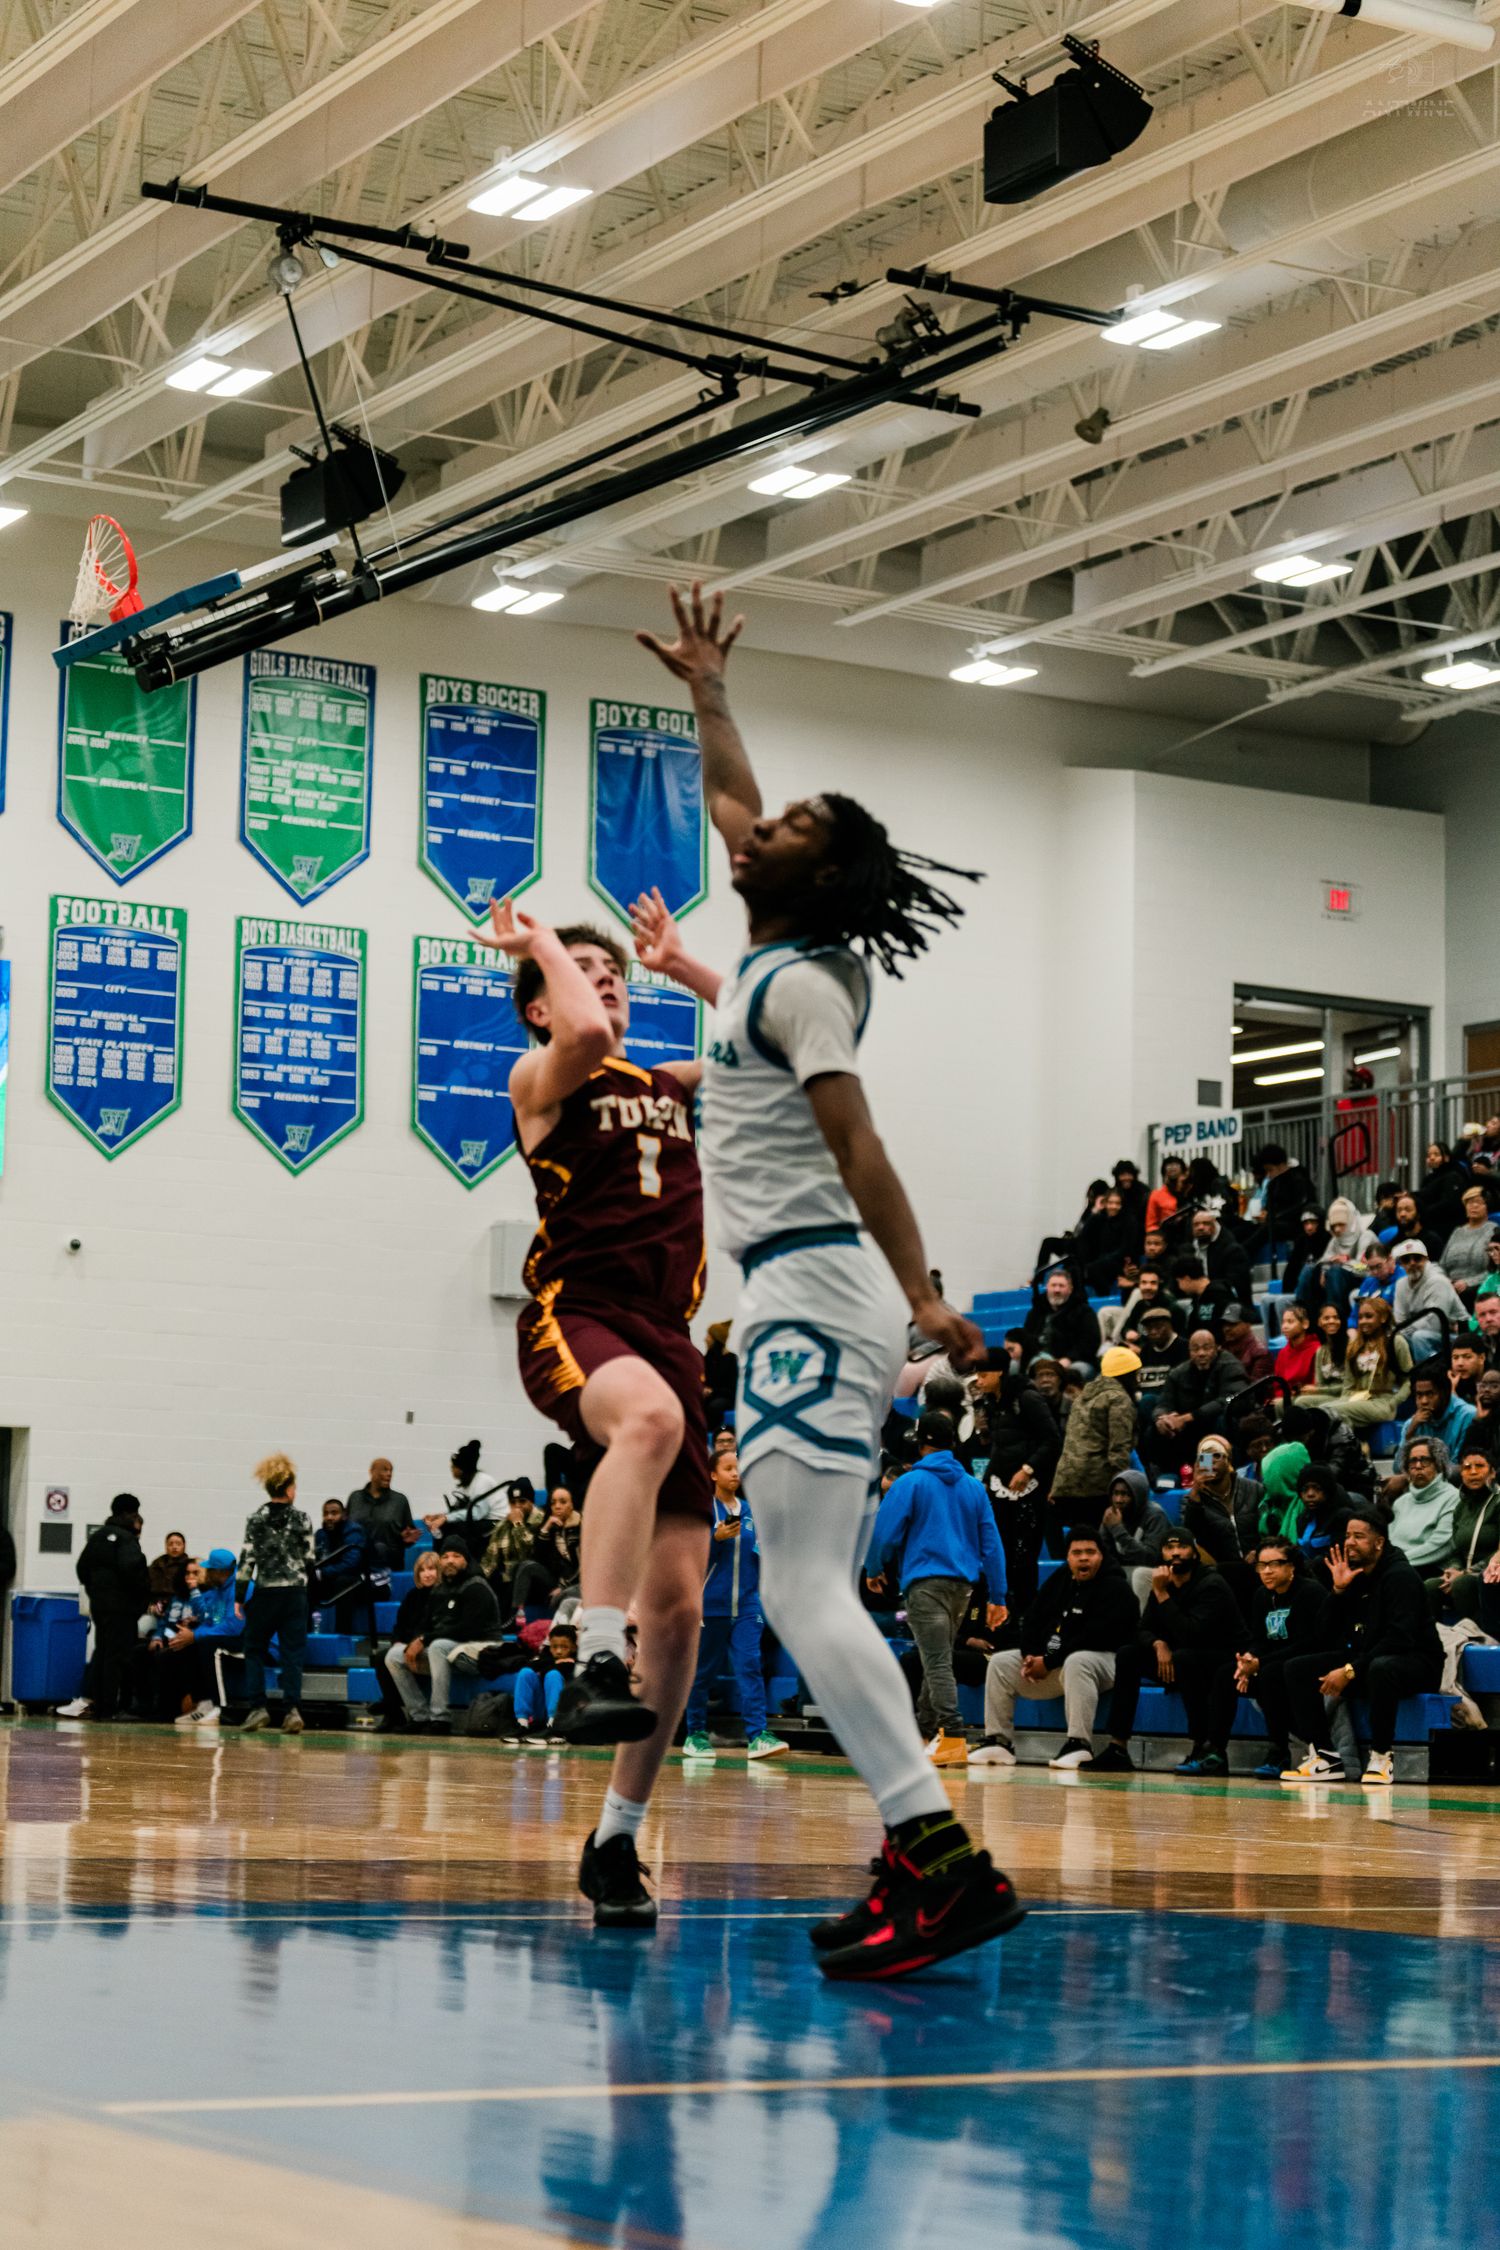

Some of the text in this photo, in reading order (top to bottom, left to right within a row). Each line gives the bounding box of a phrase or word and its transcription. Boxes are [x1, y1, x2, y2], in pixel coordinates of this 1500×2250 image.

[250, 651, 369, 693] GIRLS BASKETBALL
[426, 677, 540, 719] BOYS SOCCER
[595, 702, 651, 728] BOYS
[56, 897, 179, 937] FOOTBALL
[241, 919, 362, 957] BOYS BASKETBALL
[419, 937, 519, 971] BOYS TRA
[1164, 1116, 1238, 1146] PEP BAND
[637, 1133, 662, 1199] 1
